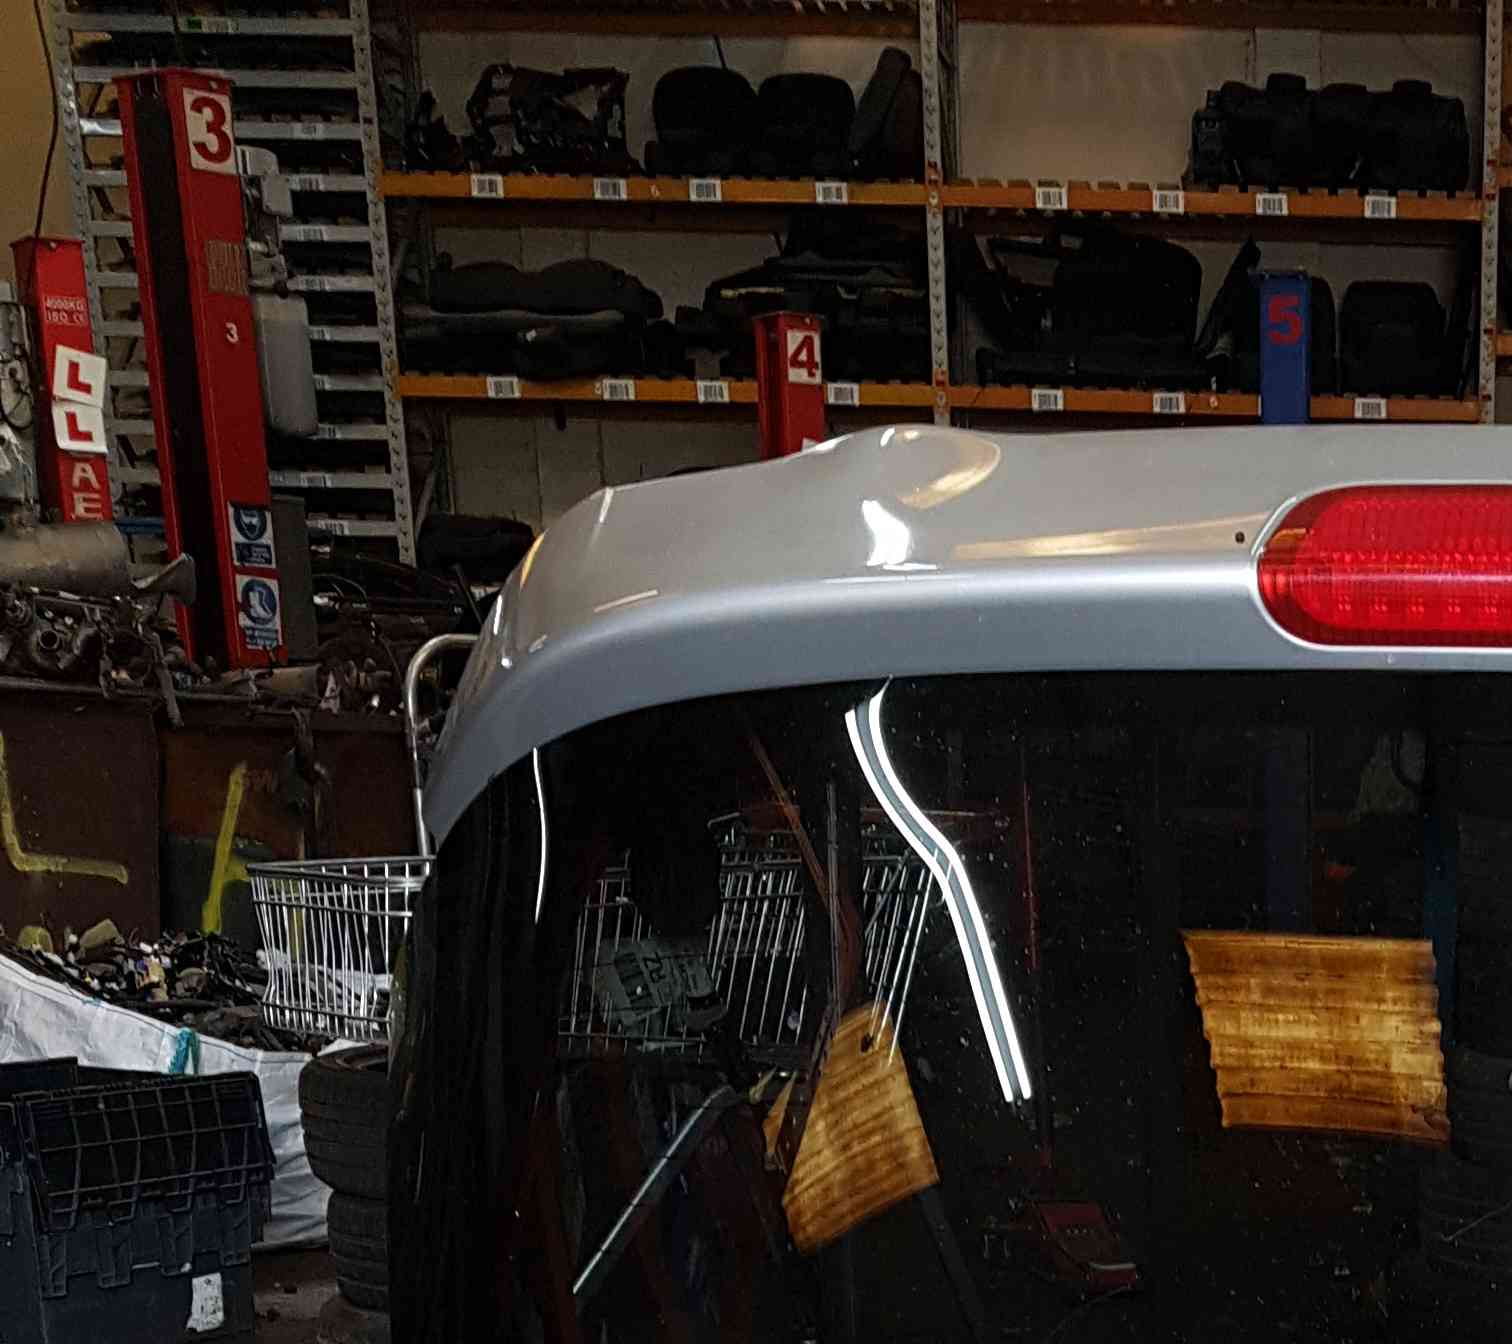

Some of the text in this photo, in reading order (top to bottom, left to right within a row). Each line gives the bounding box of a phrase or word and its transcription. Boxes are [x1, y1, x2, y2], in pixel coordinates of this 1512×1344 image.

[190, 96, 232, 164] 3
[225, 322, 239, 344] 3
[1268, 294, 1303, 345] 5
[790, 334, 819, 378] 4
[67, 359, 92, 395] L
[64, 410, 93, 442] L
